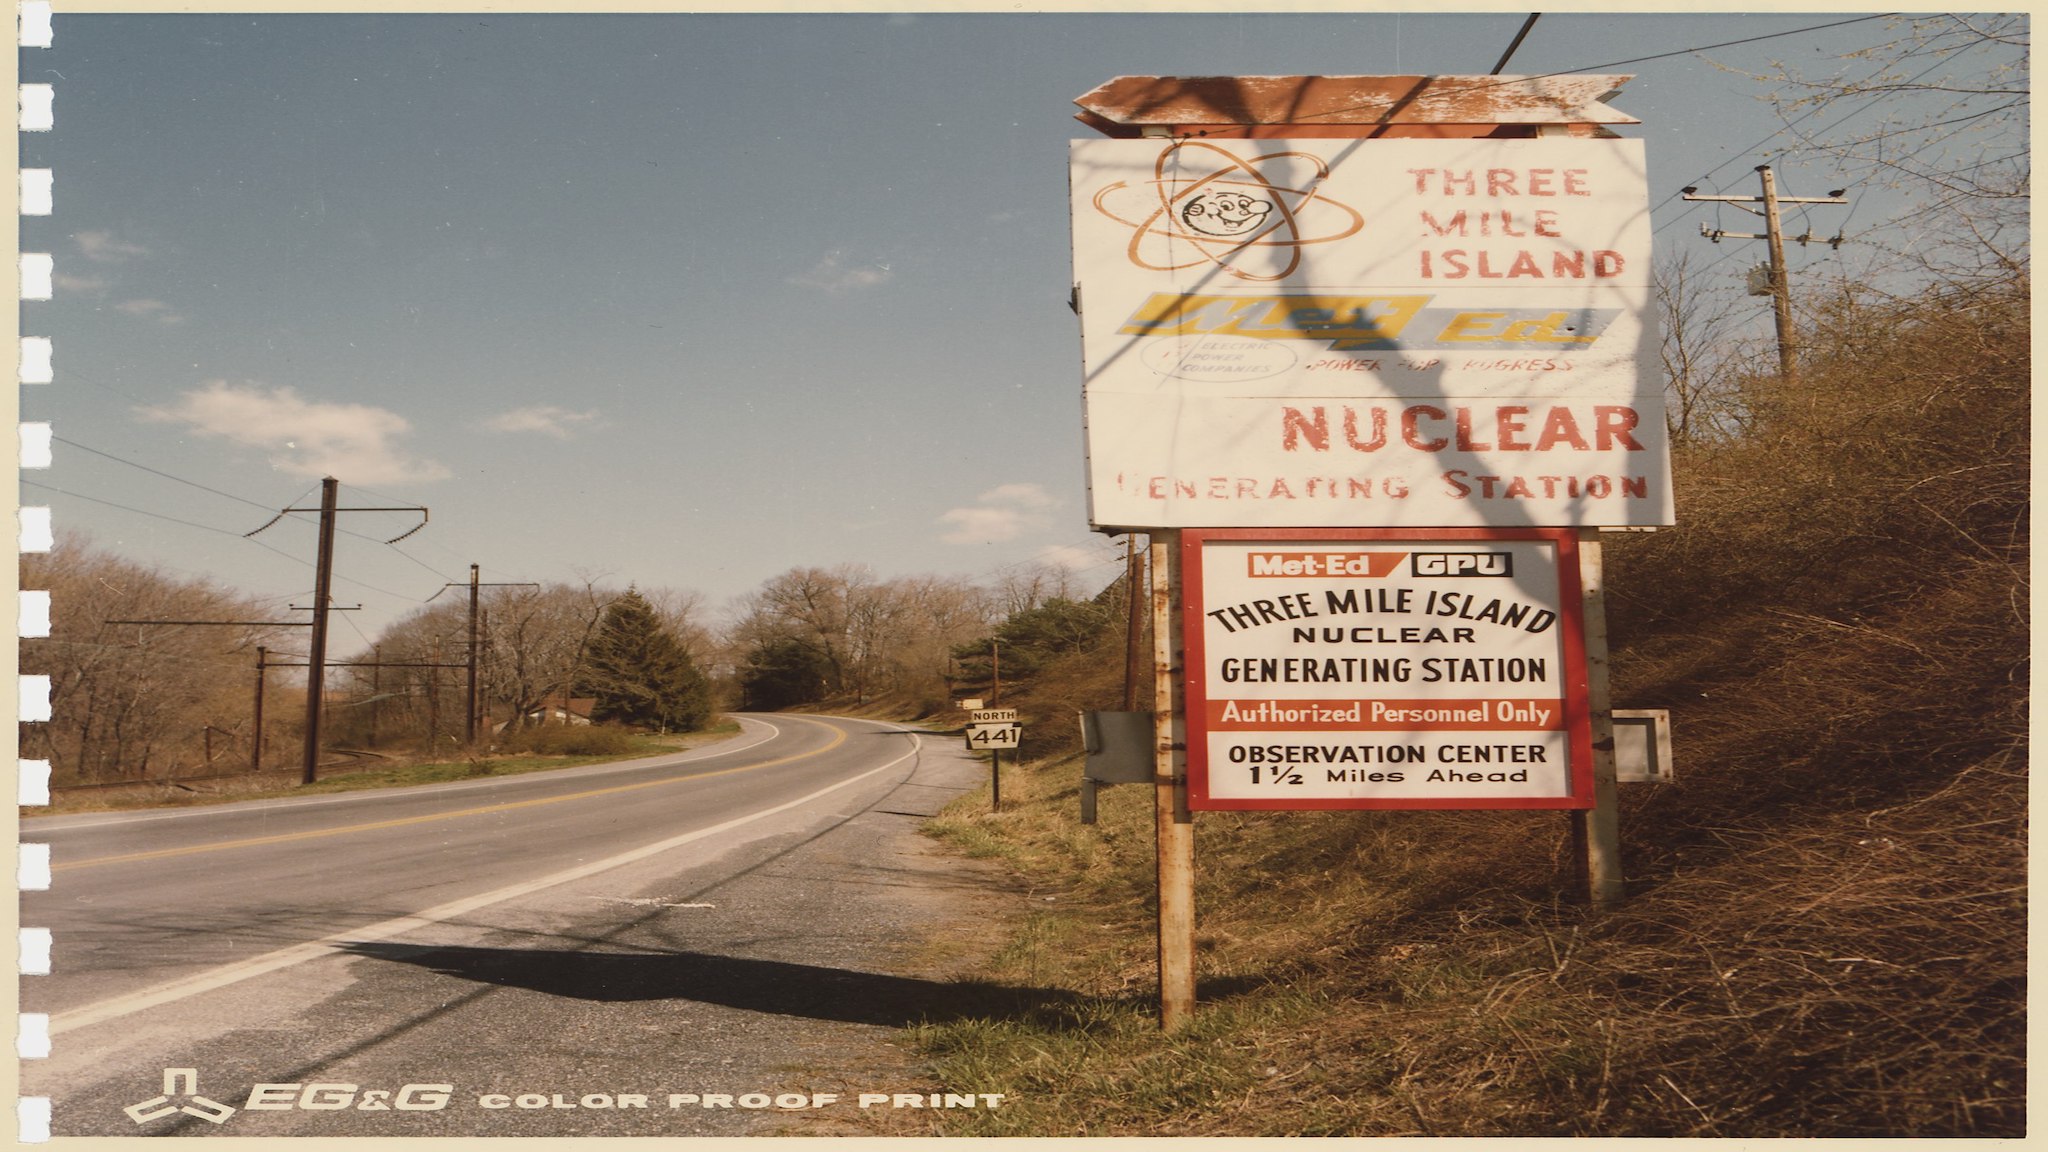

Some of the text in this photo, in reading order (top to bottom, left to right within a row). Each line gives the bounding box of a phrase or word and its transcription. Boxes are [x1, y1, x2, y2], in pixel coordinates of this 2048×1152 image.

[1406, 167, 1592, 197] THREE
[1420, 210, 1562, 238] MILE
[1420, 249, 1626, 280] ISLAND
[1202, 342, 1273, 350] ELECTRIC
[1191, 353, 1246, 361] POWER
[1181, 364, 1272, 373] COMPANIES
[1282, 404, 1647, 453] NUCLEAR
[1116, 469, 1648, 499] ENERATING STATION
[1253, 555, 1506, 576] Met-Ed GPU
[1207, 588, 1557, 634] THREE MILE ISLAND
[1292, 627, 1476, 644] NUCLEAR
[1221, 658, 1546, 683] GENERATING STATION
[973, 711, 1015, 720] NORTH
[1221, 700, 1551, 728] Authorized Personnel Only
[972, 728, 1017, 744] 441
[1228, 744, 1548, 764] OBSERVATION CENTER
[1326, 768, 1406, 784] Miles
[1426, 768, 1529, 784] Ahead
